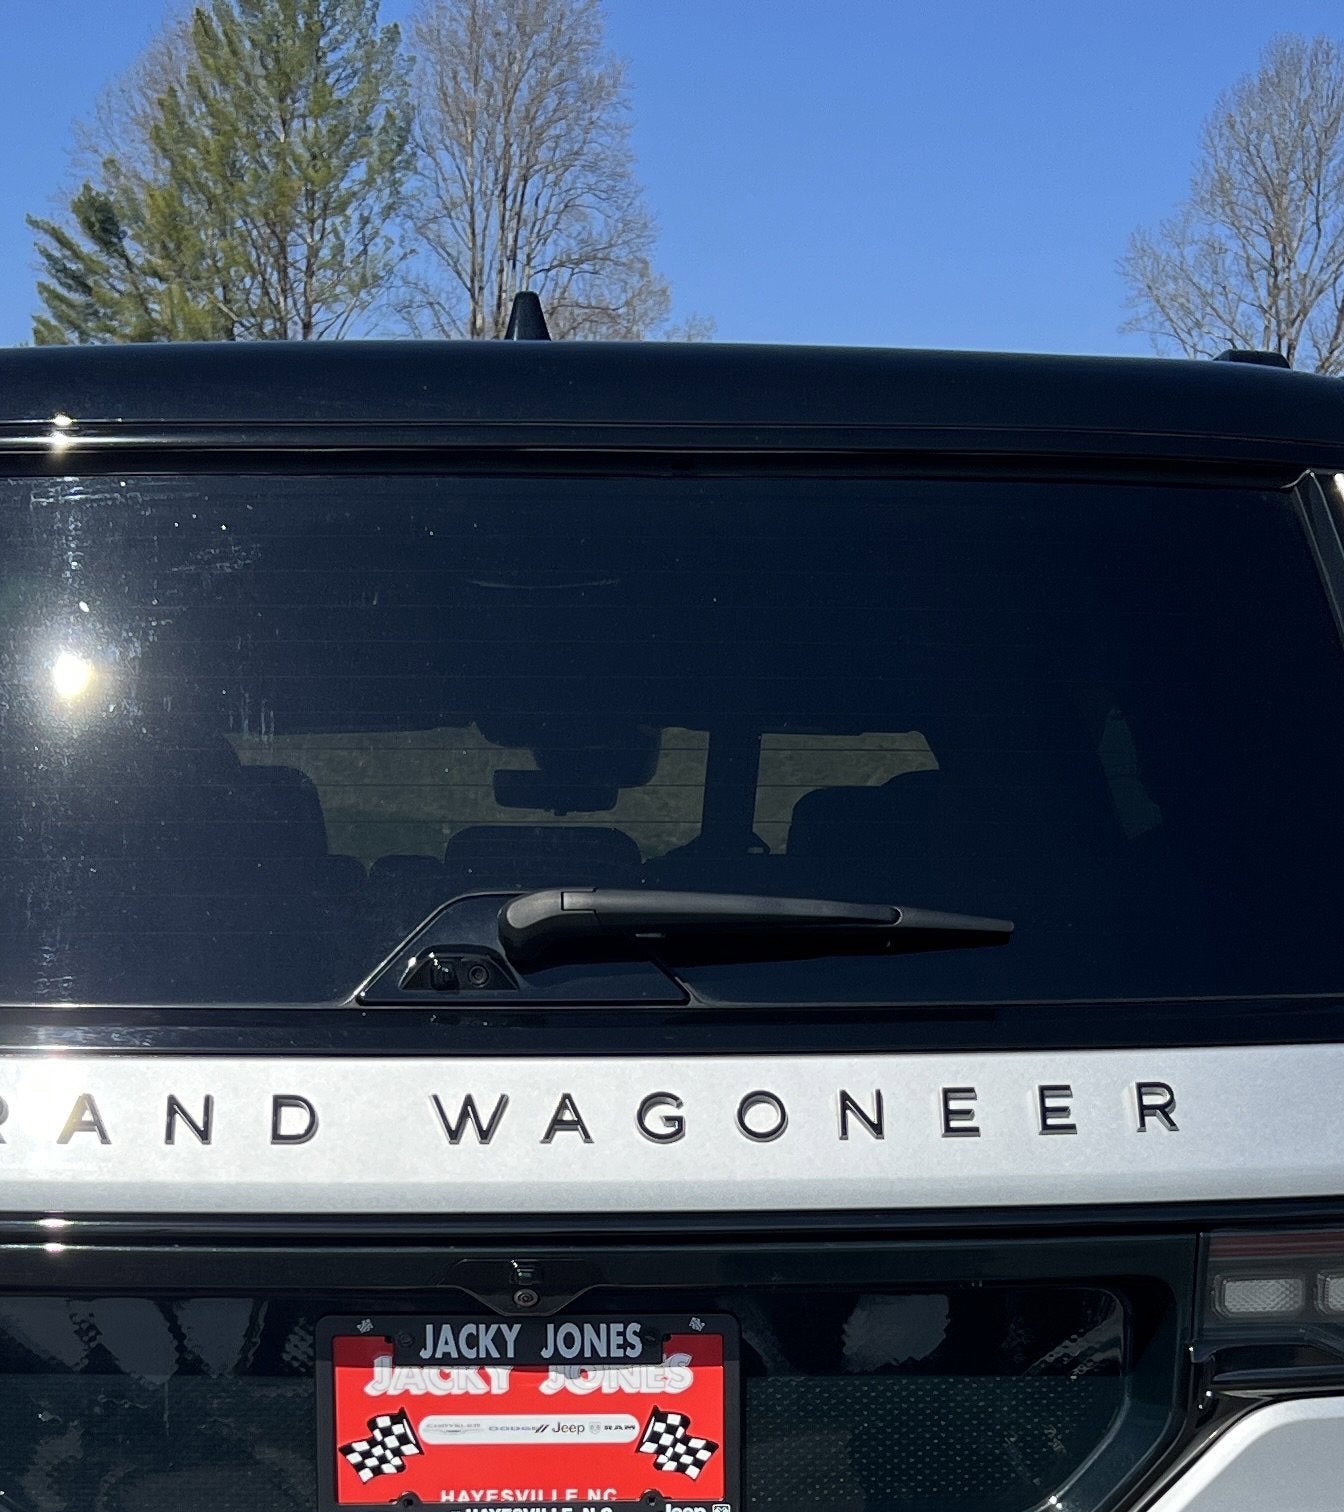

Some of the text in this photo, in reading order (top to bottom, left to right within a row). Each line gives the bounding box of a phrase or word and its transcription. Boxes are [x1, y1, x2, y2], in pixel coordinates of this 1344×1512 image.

[430, 1081, 1180, 1145] WAGONEER
[420, 1322, 642, 1359] JACKY JONES
[552, 1422, 585, 1434] Jeep
